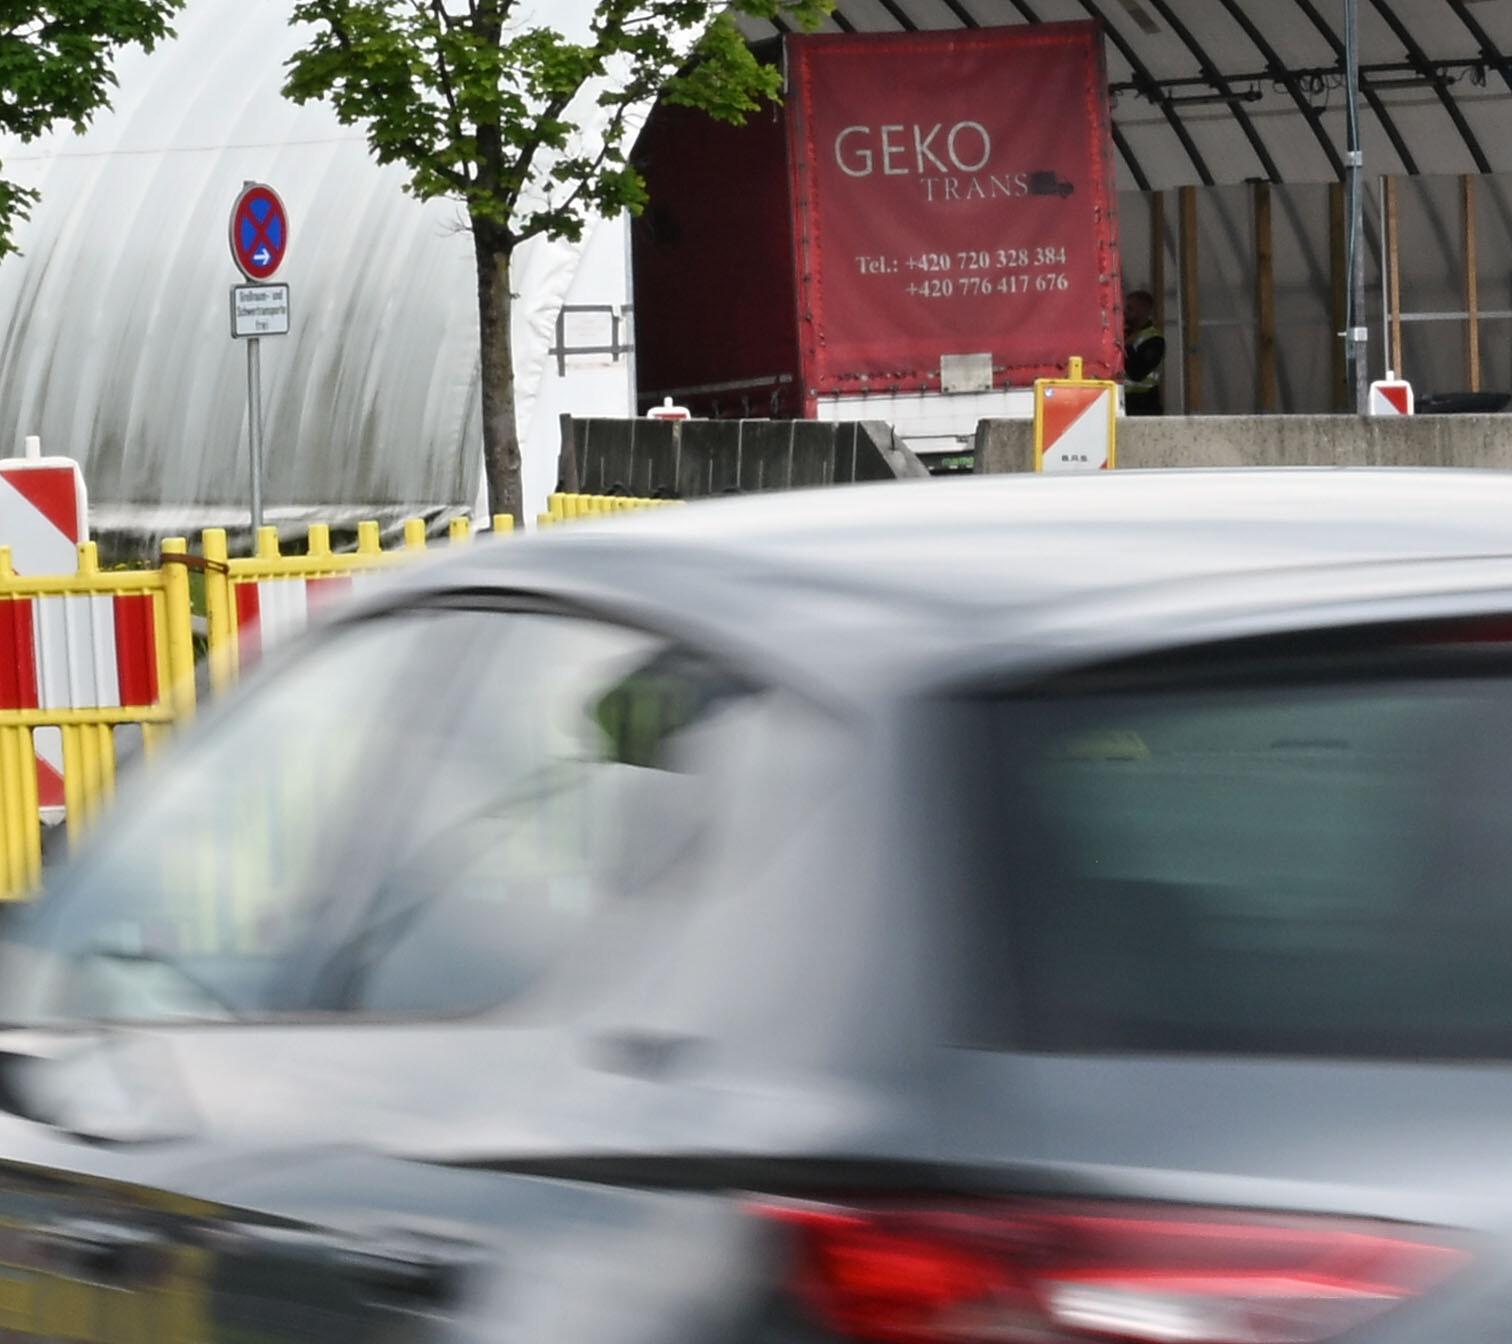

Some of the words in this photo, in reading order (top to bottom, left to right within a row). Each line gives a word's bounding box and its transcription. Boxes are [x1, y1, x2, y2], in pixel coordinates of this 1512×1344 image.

[834, 120, 992, 178] GEKO
[920, 172, 1028, 202] TRANS
[855, 255, 899, 274] Tel.:
[905, 253, 951, 272] +420
[957, 250, 990, 270] 720
[996, 249, 1029, 268] 328
[1033, 246, 1067, 266] 384
[905, 278, 953, 297] +420
[959, 277, 992, 296] 776
[996, 275, 1029, 293] 417
[1035, 272, 1069, 291] 676
